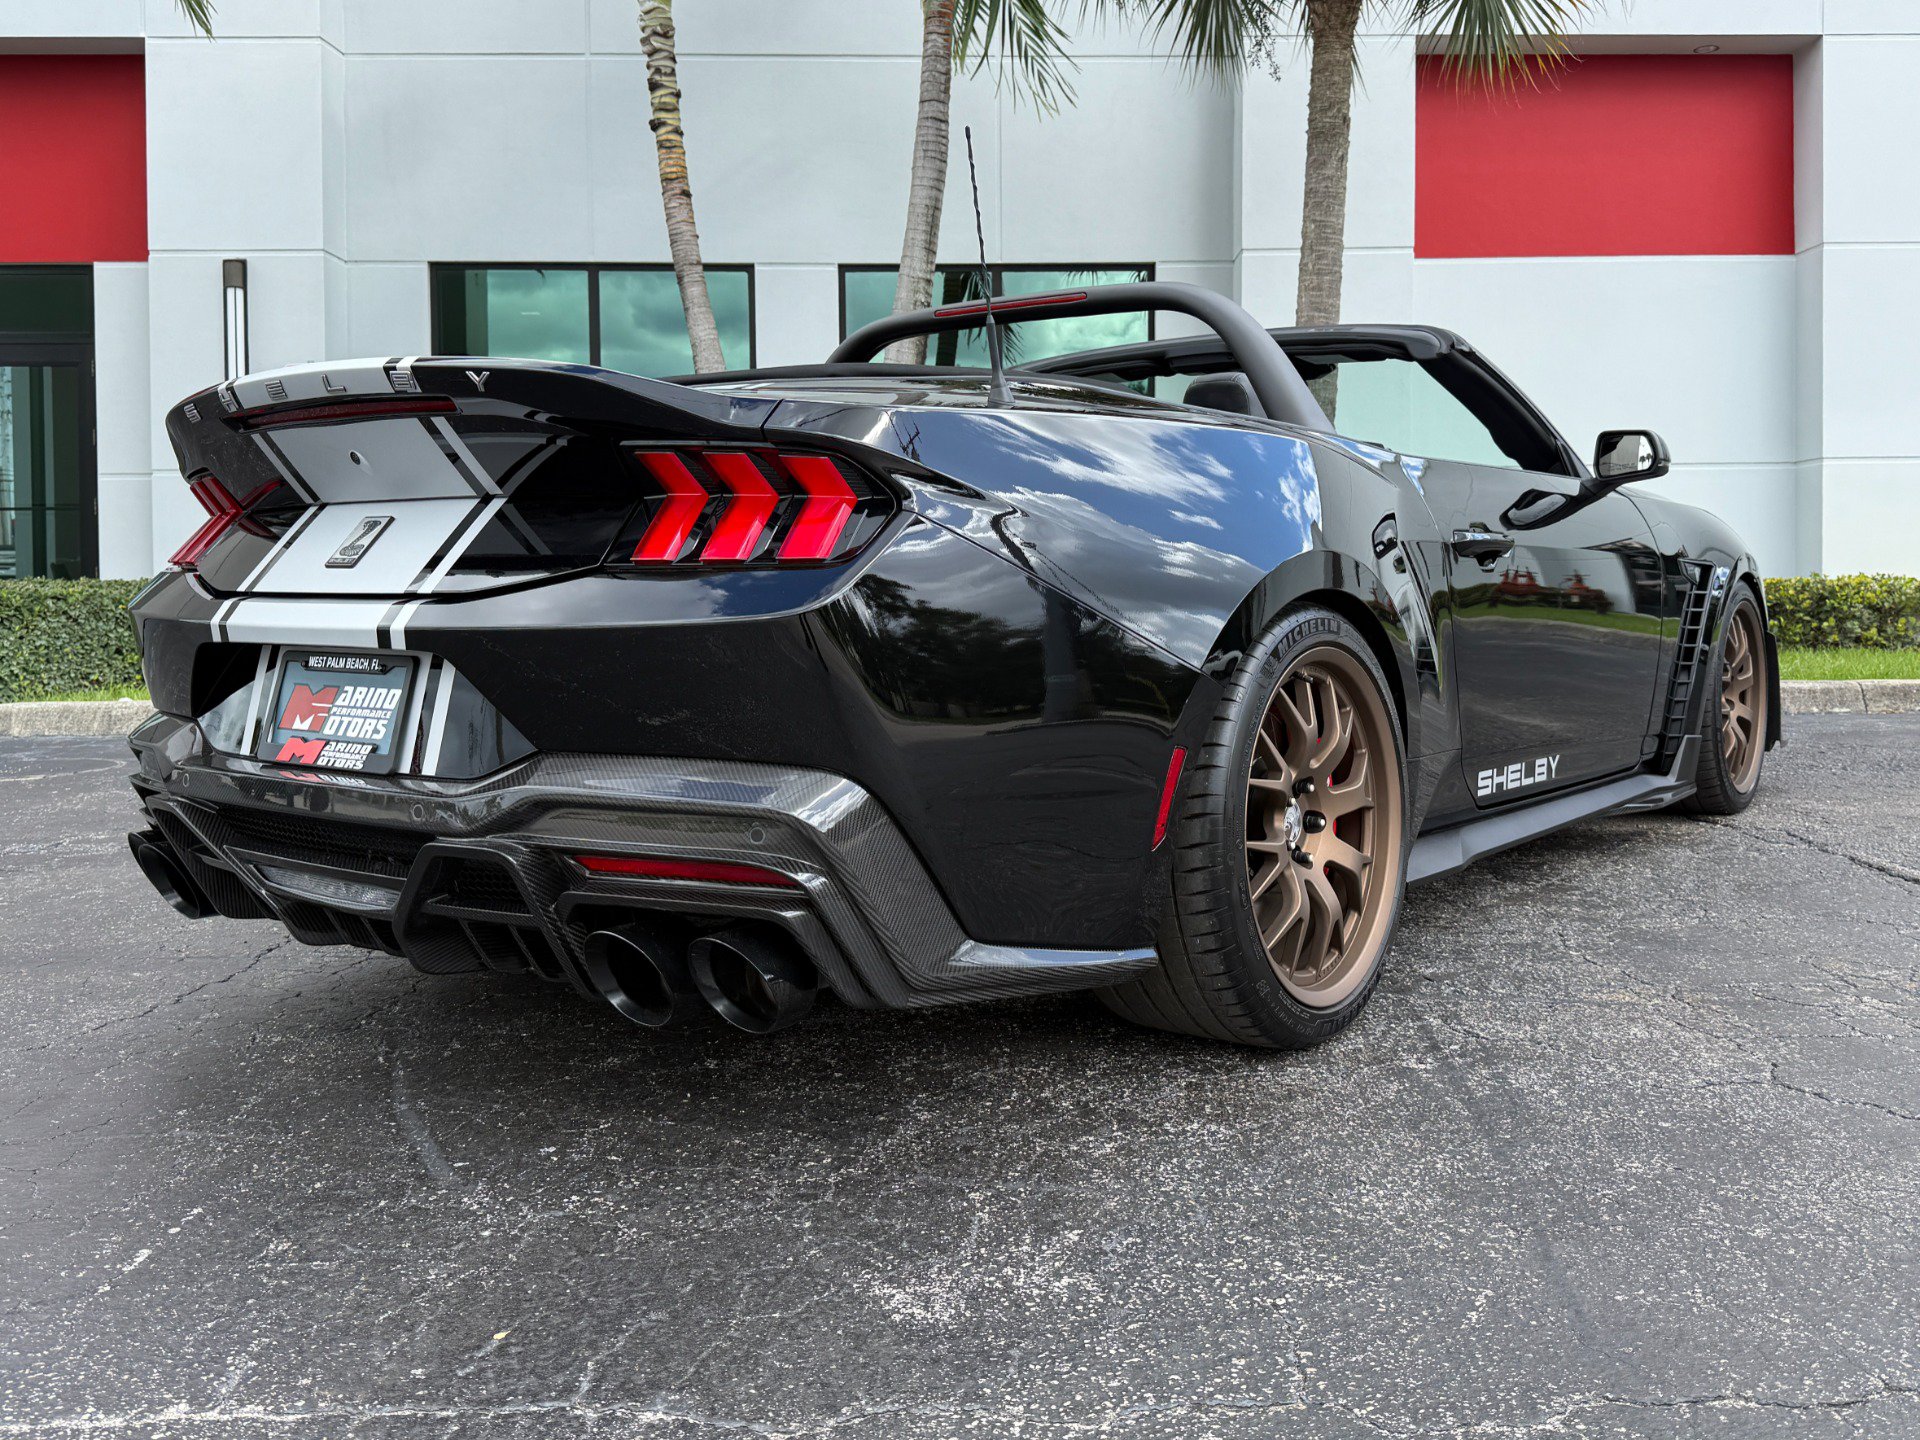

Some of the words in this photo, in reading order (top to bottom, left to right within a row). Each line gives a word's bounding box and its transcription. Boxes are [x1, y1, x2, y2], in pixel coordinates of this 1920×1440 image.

[183, 370, 490, 424] SHELBY
[1277, 618, 1338, 658] MICHELIN
[308, 656, 326, 667] WEST
[326, 656, 345, 668] PALM
[346, 657, 369, 671] BEACH,
[1477, 754, 1560, 797] SHELBY
